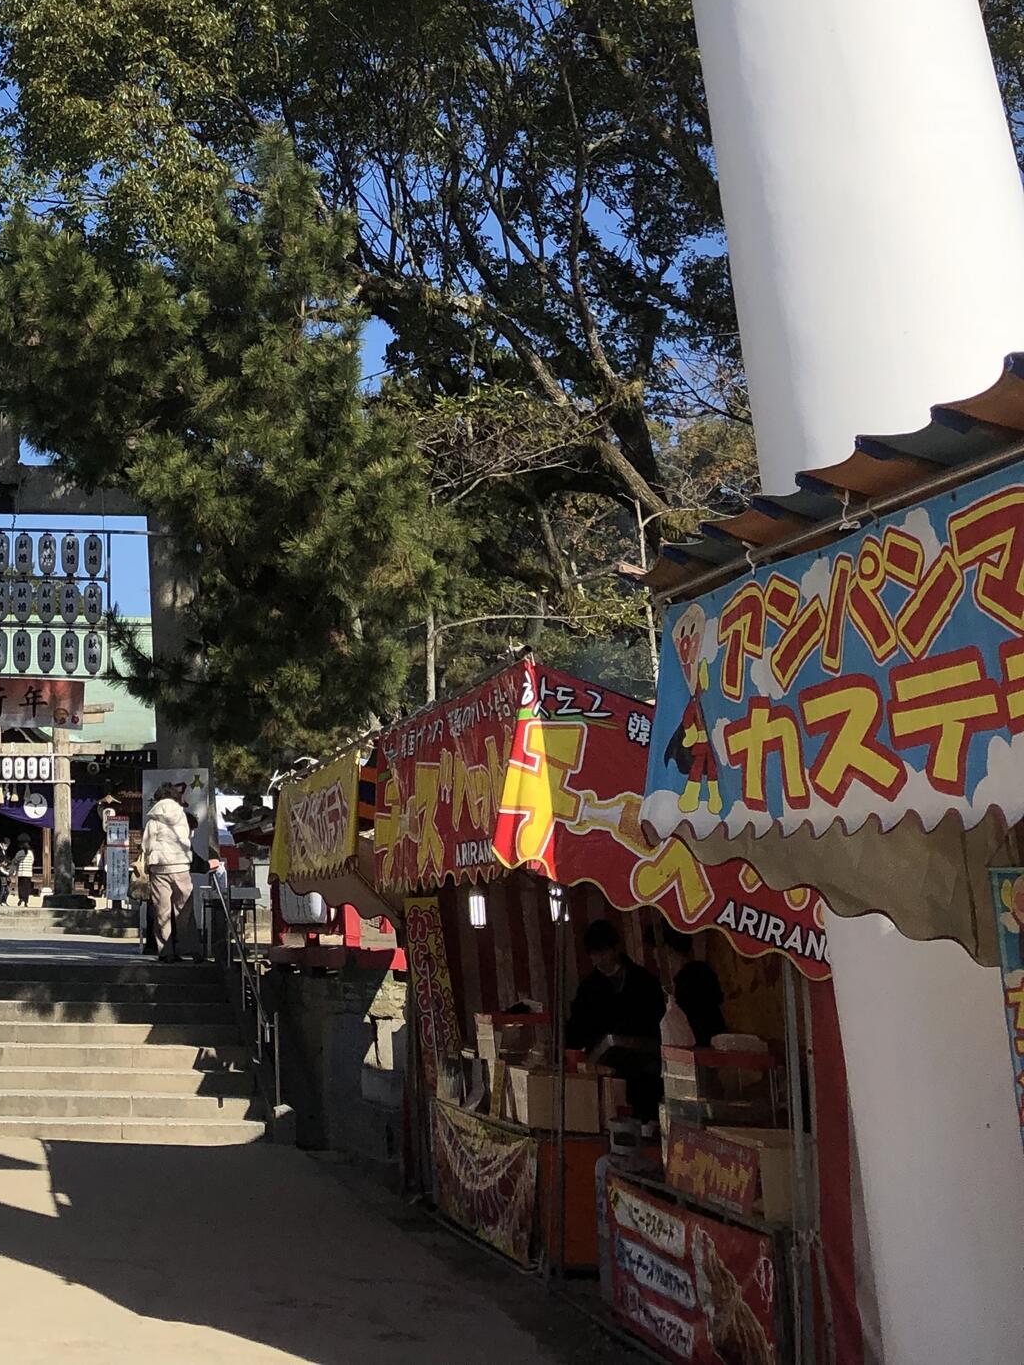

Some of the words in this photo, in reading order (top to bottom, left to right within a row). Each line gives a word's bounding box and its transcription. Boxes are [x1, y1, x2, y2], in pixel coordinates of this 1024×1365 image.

[521, 670, 613, 718] 핫도그
[724, 637, 1024, 812] カステ
